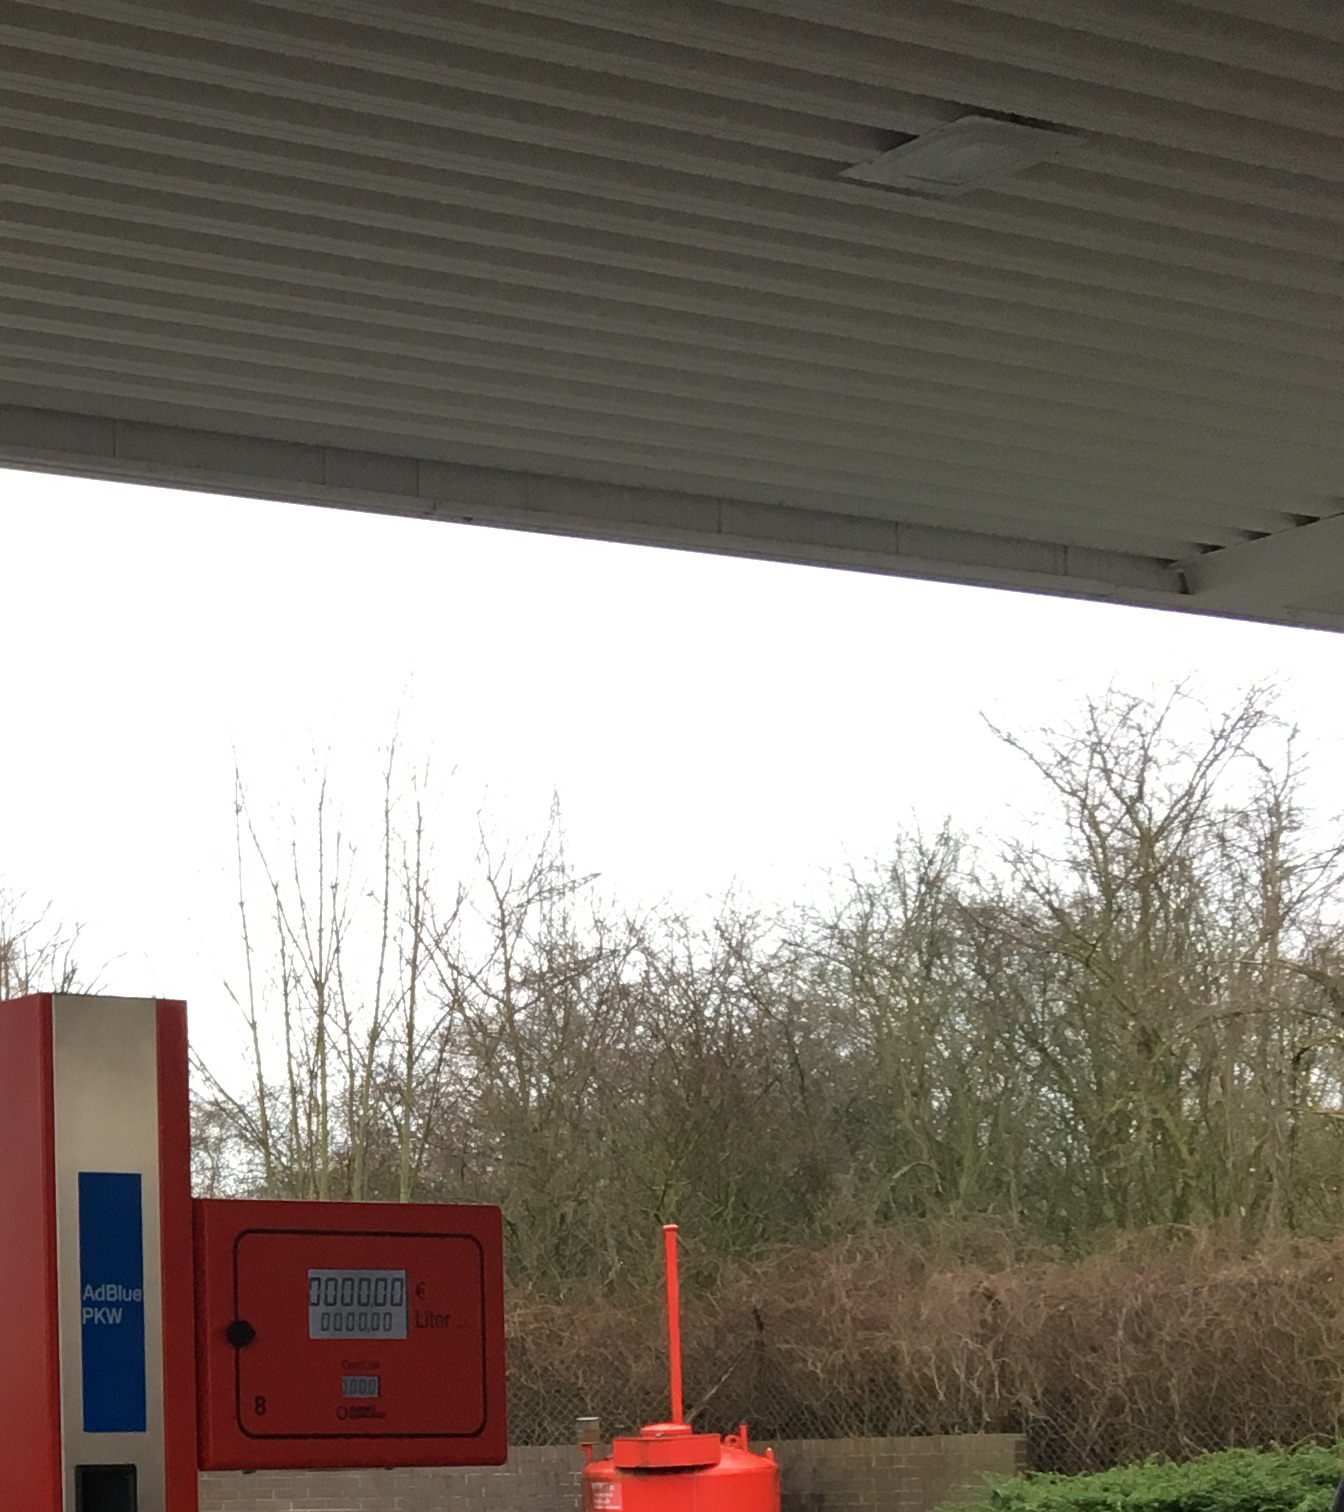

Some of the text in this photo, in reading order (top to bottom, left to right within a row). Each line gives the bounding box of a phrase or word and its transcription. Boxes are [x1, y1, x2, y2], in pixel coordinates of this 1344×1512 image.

[82, 1283, 143, 1302] AdBlue
[414, 1280, 428, 1301] €
[82, 1307, 123, 1325] PKW
[414, 1309, 452, 1330] Liter
